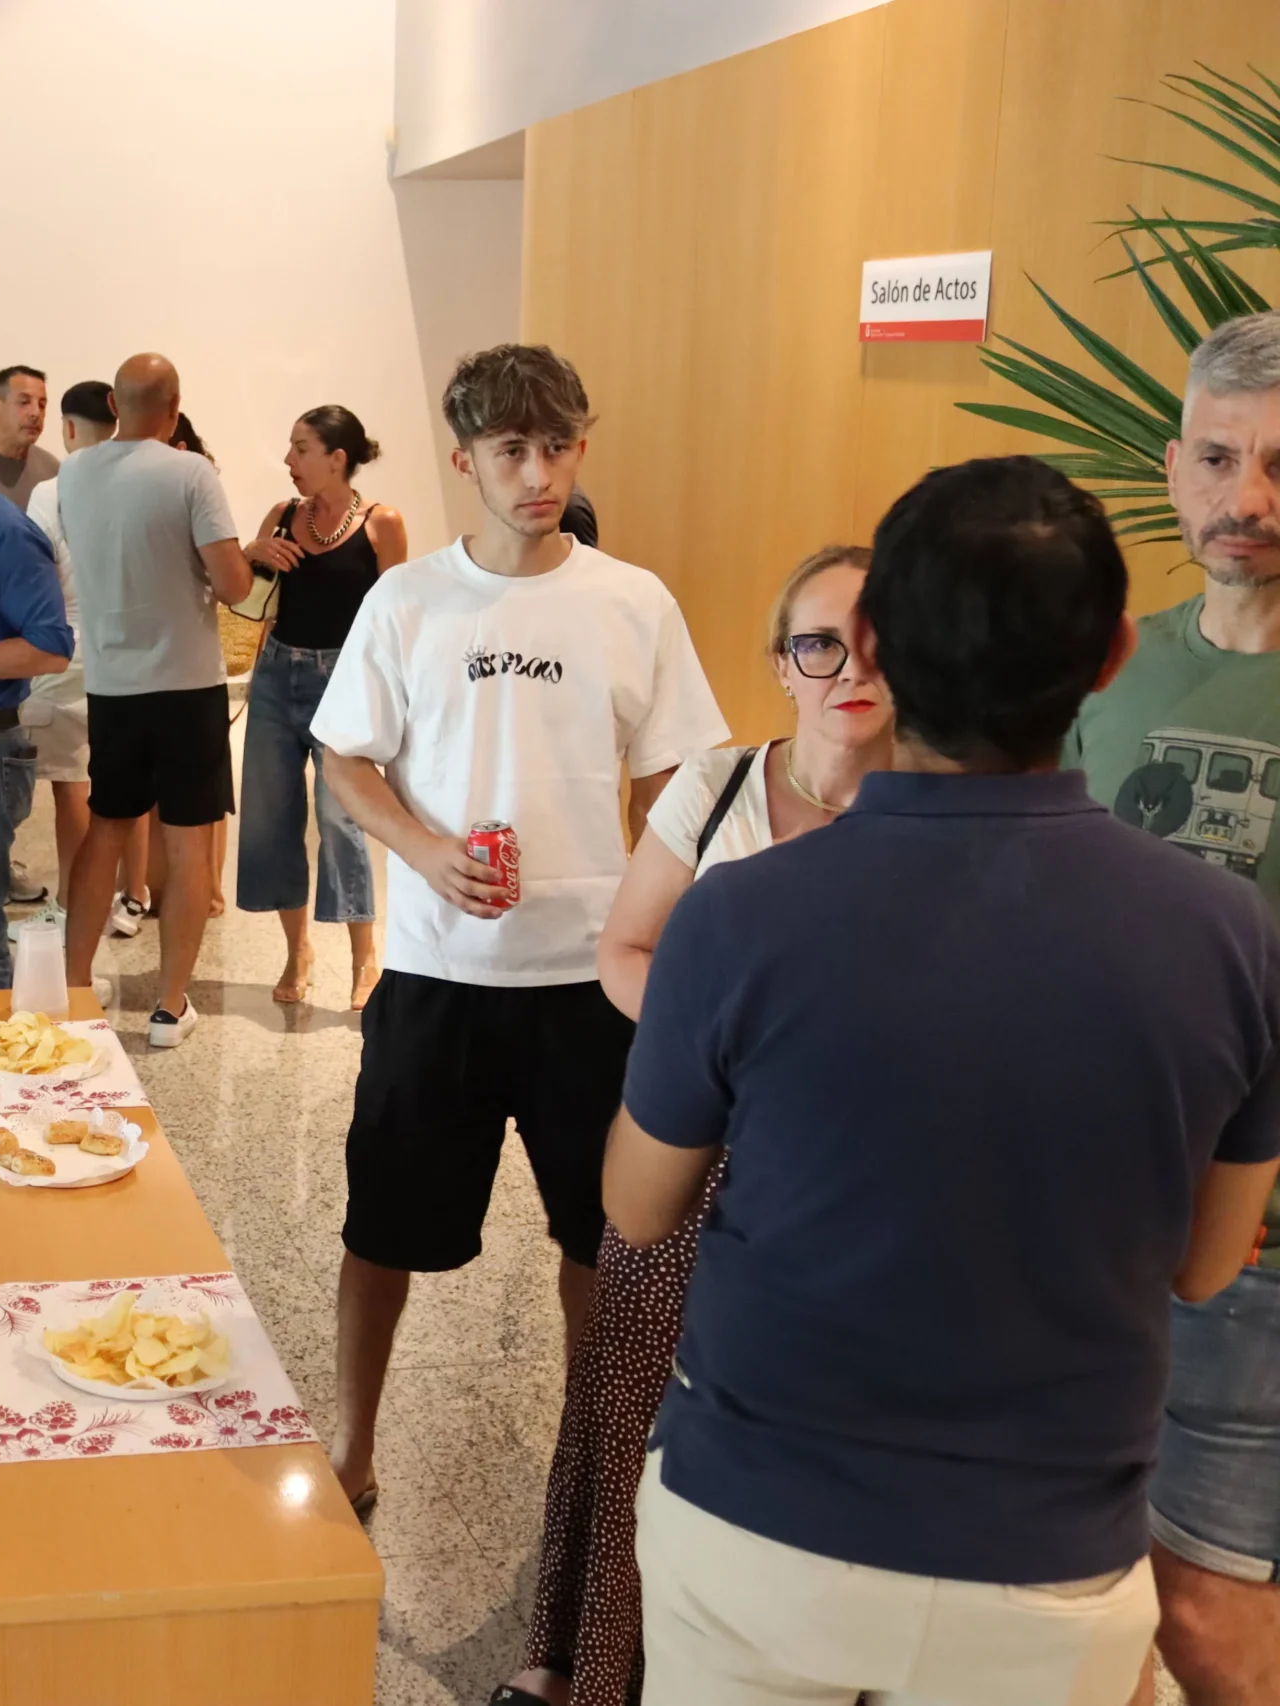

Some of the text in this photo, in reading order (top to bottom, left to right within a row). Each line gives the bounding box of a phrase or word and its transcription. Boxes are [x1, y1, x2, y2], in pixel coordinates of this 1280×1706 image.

[871, 276, 977, 304] Salón de Actos
[501, 651, 563, 684] FLOW
